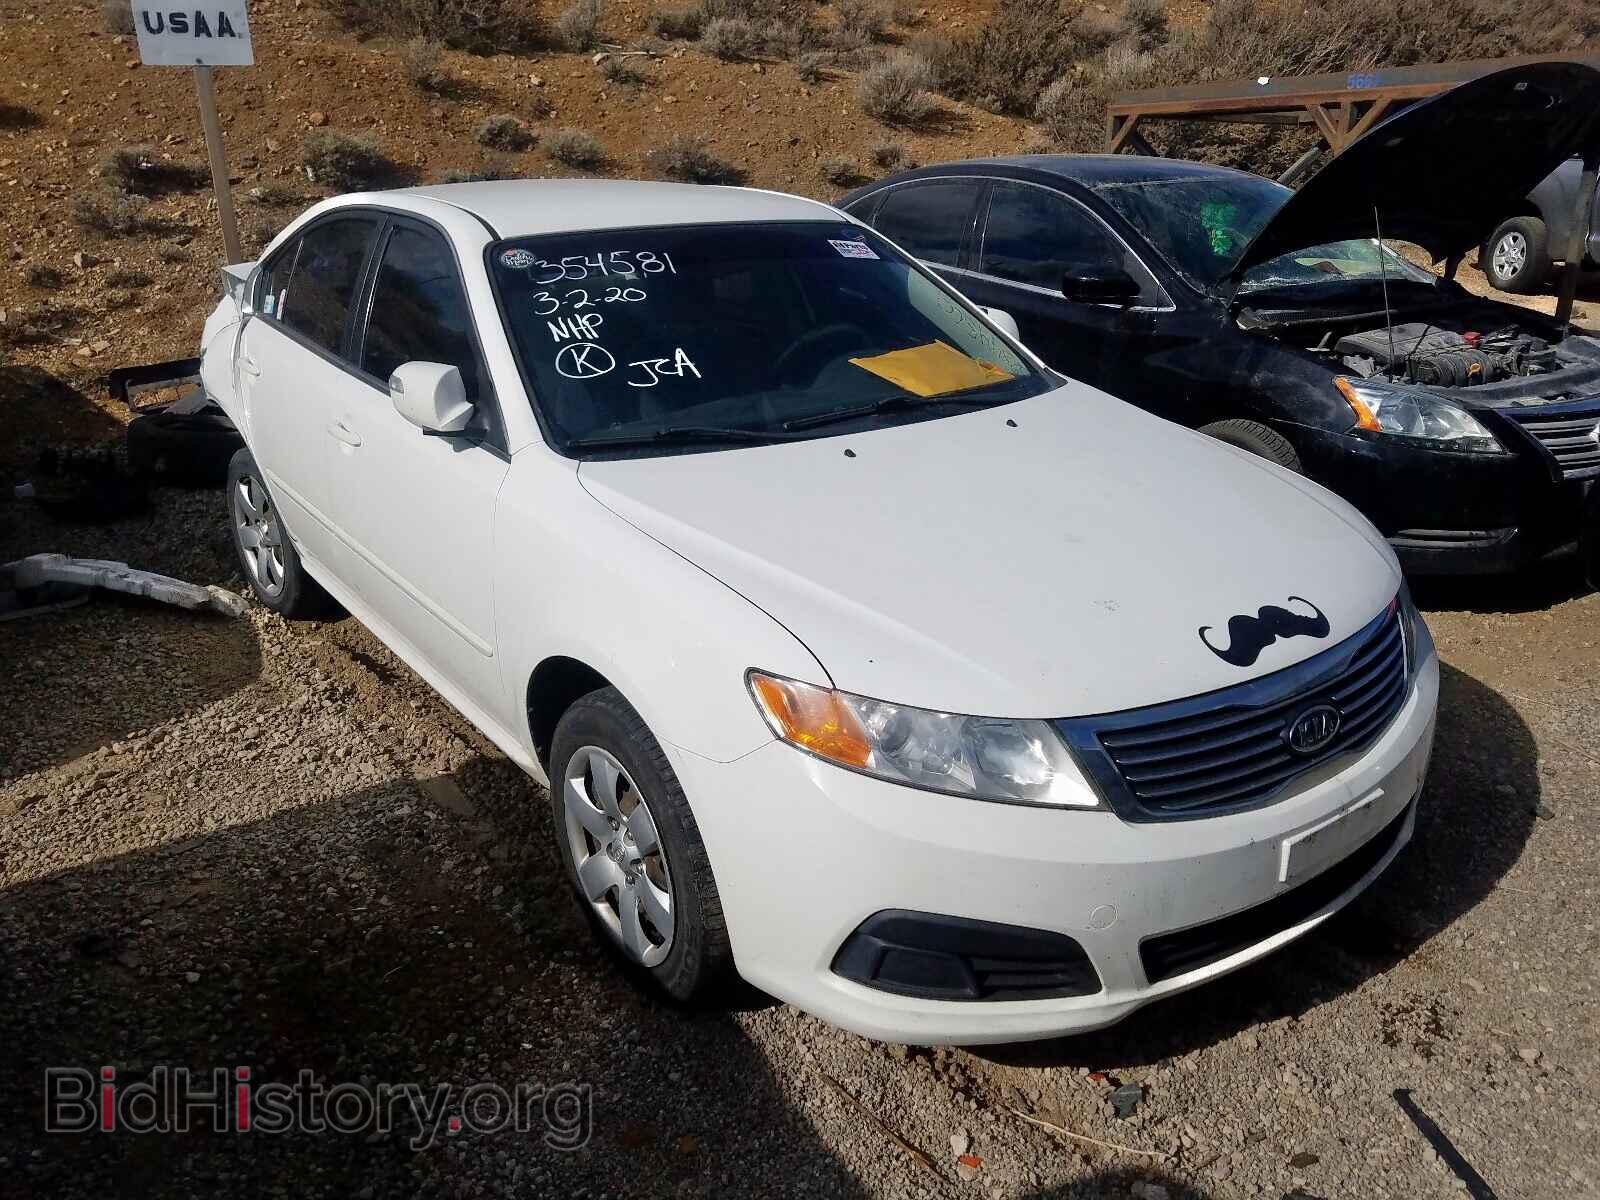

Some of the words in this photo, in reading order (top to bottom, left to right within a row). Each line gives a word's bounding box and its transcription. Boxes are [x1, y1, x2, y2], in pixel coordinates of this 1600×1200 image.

[534, 251, 677, 284] 354581
[532, 286, 647, 315] 3-2-20
[546, 312, 604, 342] NHP
